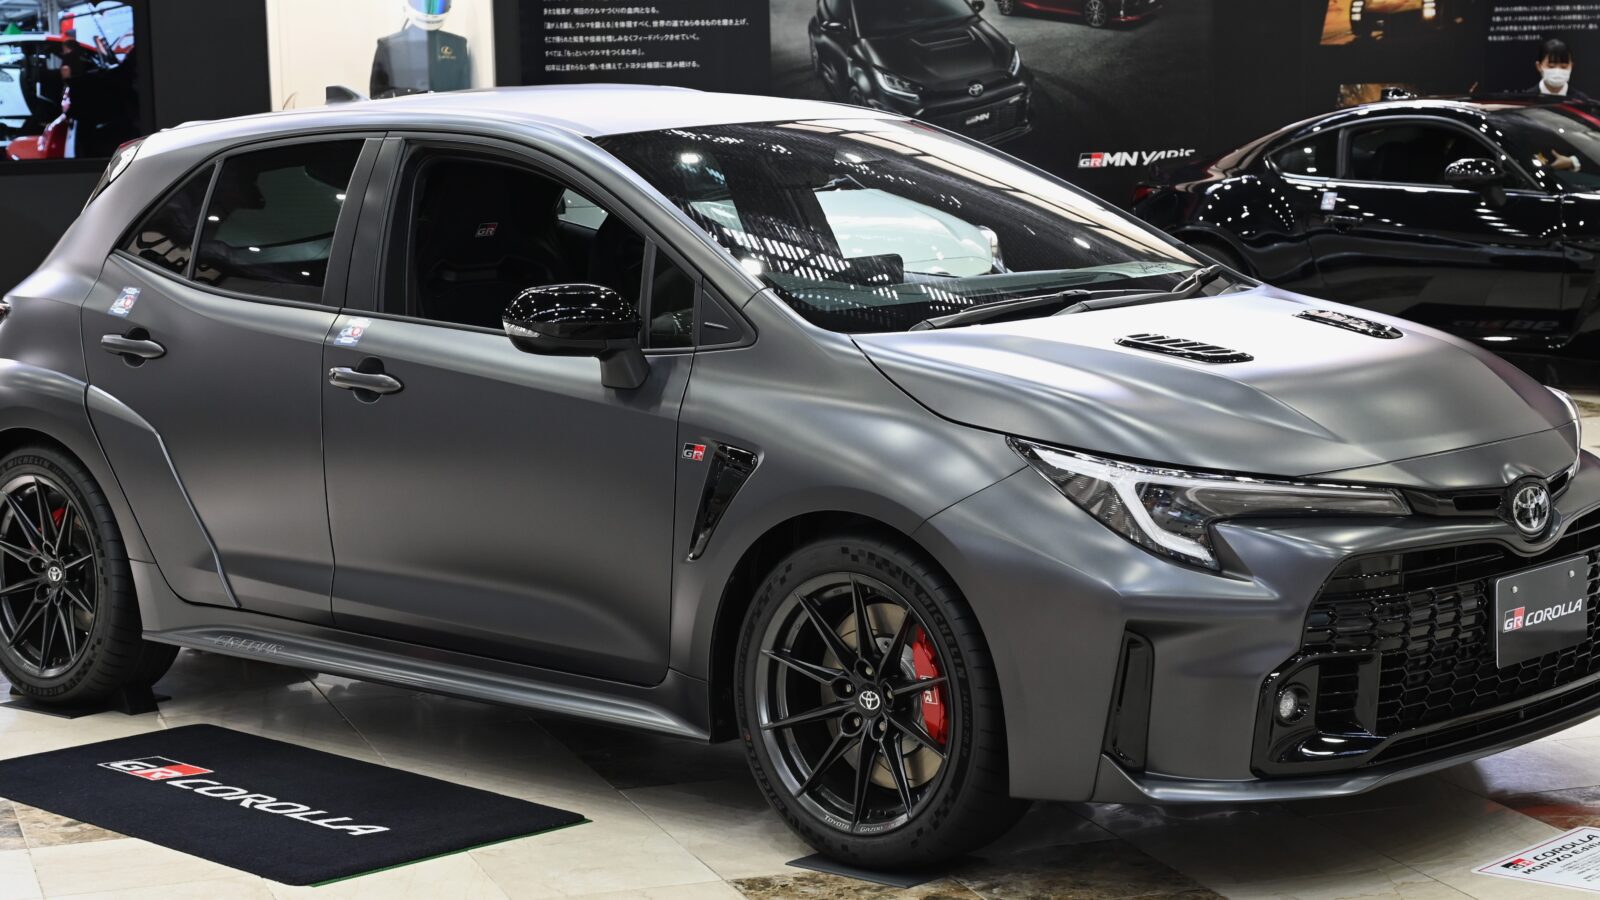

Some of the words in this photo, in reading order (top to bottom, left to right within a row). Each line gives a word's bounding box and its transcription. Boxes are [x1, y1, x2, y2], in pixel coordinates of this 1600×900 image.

[476, 225, 496, 237] GR
[683, 447, 704, 461] GR
[1502, 613, 1524, 632] GR
[1525, 597, 1583, 627] COROLLA
[918, 591, 967, 680] MICHELIN
[108, 759, 188, 780] GR
[166, 779, 391, 836] COROLLA
[824, 814, 850, 830] TOYOTA
[1533, 833, 1600, 861] COROLLA
[1522, 853, 1573, 875] MORIZO
